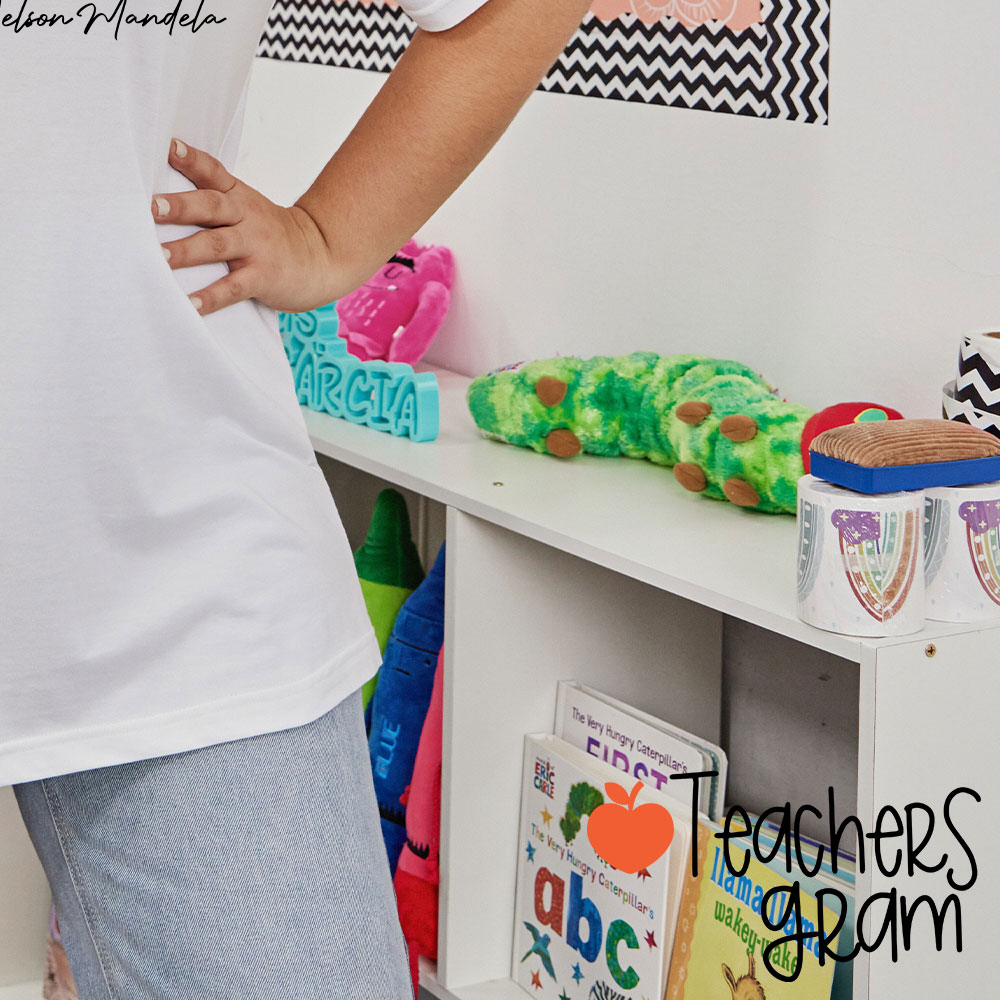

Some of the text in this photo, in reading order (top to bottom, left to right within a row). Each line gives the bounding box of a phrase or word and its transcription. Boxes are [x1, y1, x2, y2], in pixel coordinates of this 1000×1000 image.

[295, 351, 419, 436] ARCIA
[374, 716, 401, 779] BLUE
[535, 761, 556, 786] ERIC
[572, 706, 688, 774] The Very Hungry Caterpillar's
[534, 775, 555, 800] CARLE
[531, 822, 655, 921] The Very Hungry Caterpillar's
[710, 846, 764, 916] llama
[534, 866, 640, 991] abc
